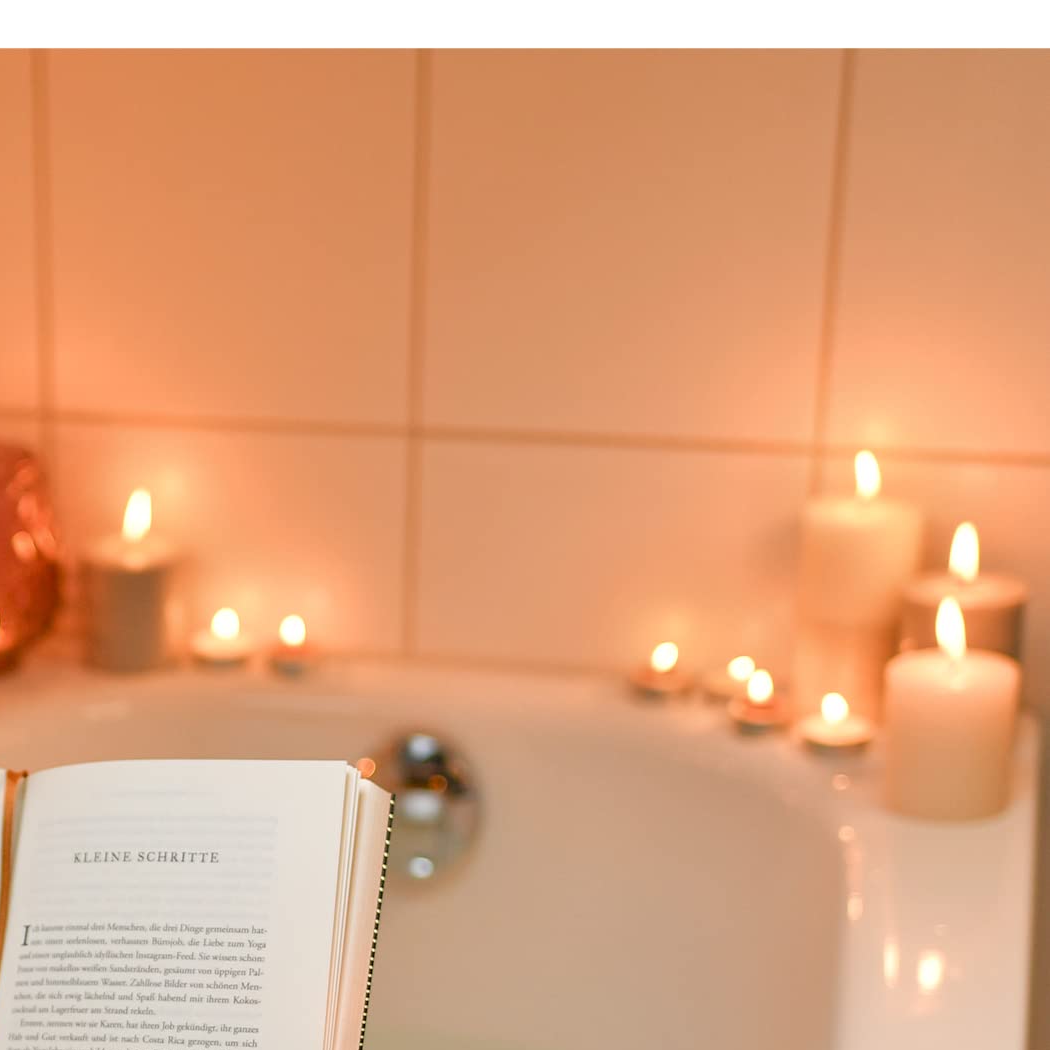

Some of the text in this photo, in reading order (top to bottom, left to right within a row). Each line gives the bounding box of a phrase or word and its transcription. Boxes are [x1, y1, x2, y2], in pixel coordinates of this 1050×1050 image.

[73, 850, 220, 864] KLEINE SCHRITTE
[149, 924, 161, 932] die
[163, 924, 178, 932] drei
[180, 925, 204, 935] Dinge
[205, 926, 250, 935] gemeinsam
[251, 926, 267, 935] hat-
[187, 938, 200, 946] die
[203, 939, 225, 947] Liebe
[248, 941, 267, 951] Yoga
[198, 953, 210, 961] Sie
[212, 954, 238, 962] wissen
[163, 967, 196, 976] gesäumt
[214, 968, 247, 978] üppigen
[248, 969, 263, 977] Pal-
[130, 979, 162, 987] Zahllose
[164, 980, 187, 988] Bilder
[206, 981, 239, 990] schönen
[241, 983, 262, 991] Men-
[136, 993, 156, 1004] Spaß
[157, 993, 187, 1002] habend
[189, 995, 203, 1003] mit
[206, 995, 230, 1004] ihrem
[233, 996, 261, 1005] Kokos-
[126, 1020, 138, 1029] hat
[140, 1020, 160, 1030] ihren
[162, 1021, 175, 1031] Job
[176, 1022, 217, 1034] gekündigt,
[220, 1023, 232, 1033] ihr
[233, 1027, 259, 1035] ganzes
[121, 1034, 140, 1043] nach
[142, 1035, 165, 1044] Costa
[167, 1036, 185, 1045] Rica
[187, 1039, 222, 1048] gezogen,
[242, 1039, 258, 1048] sich
